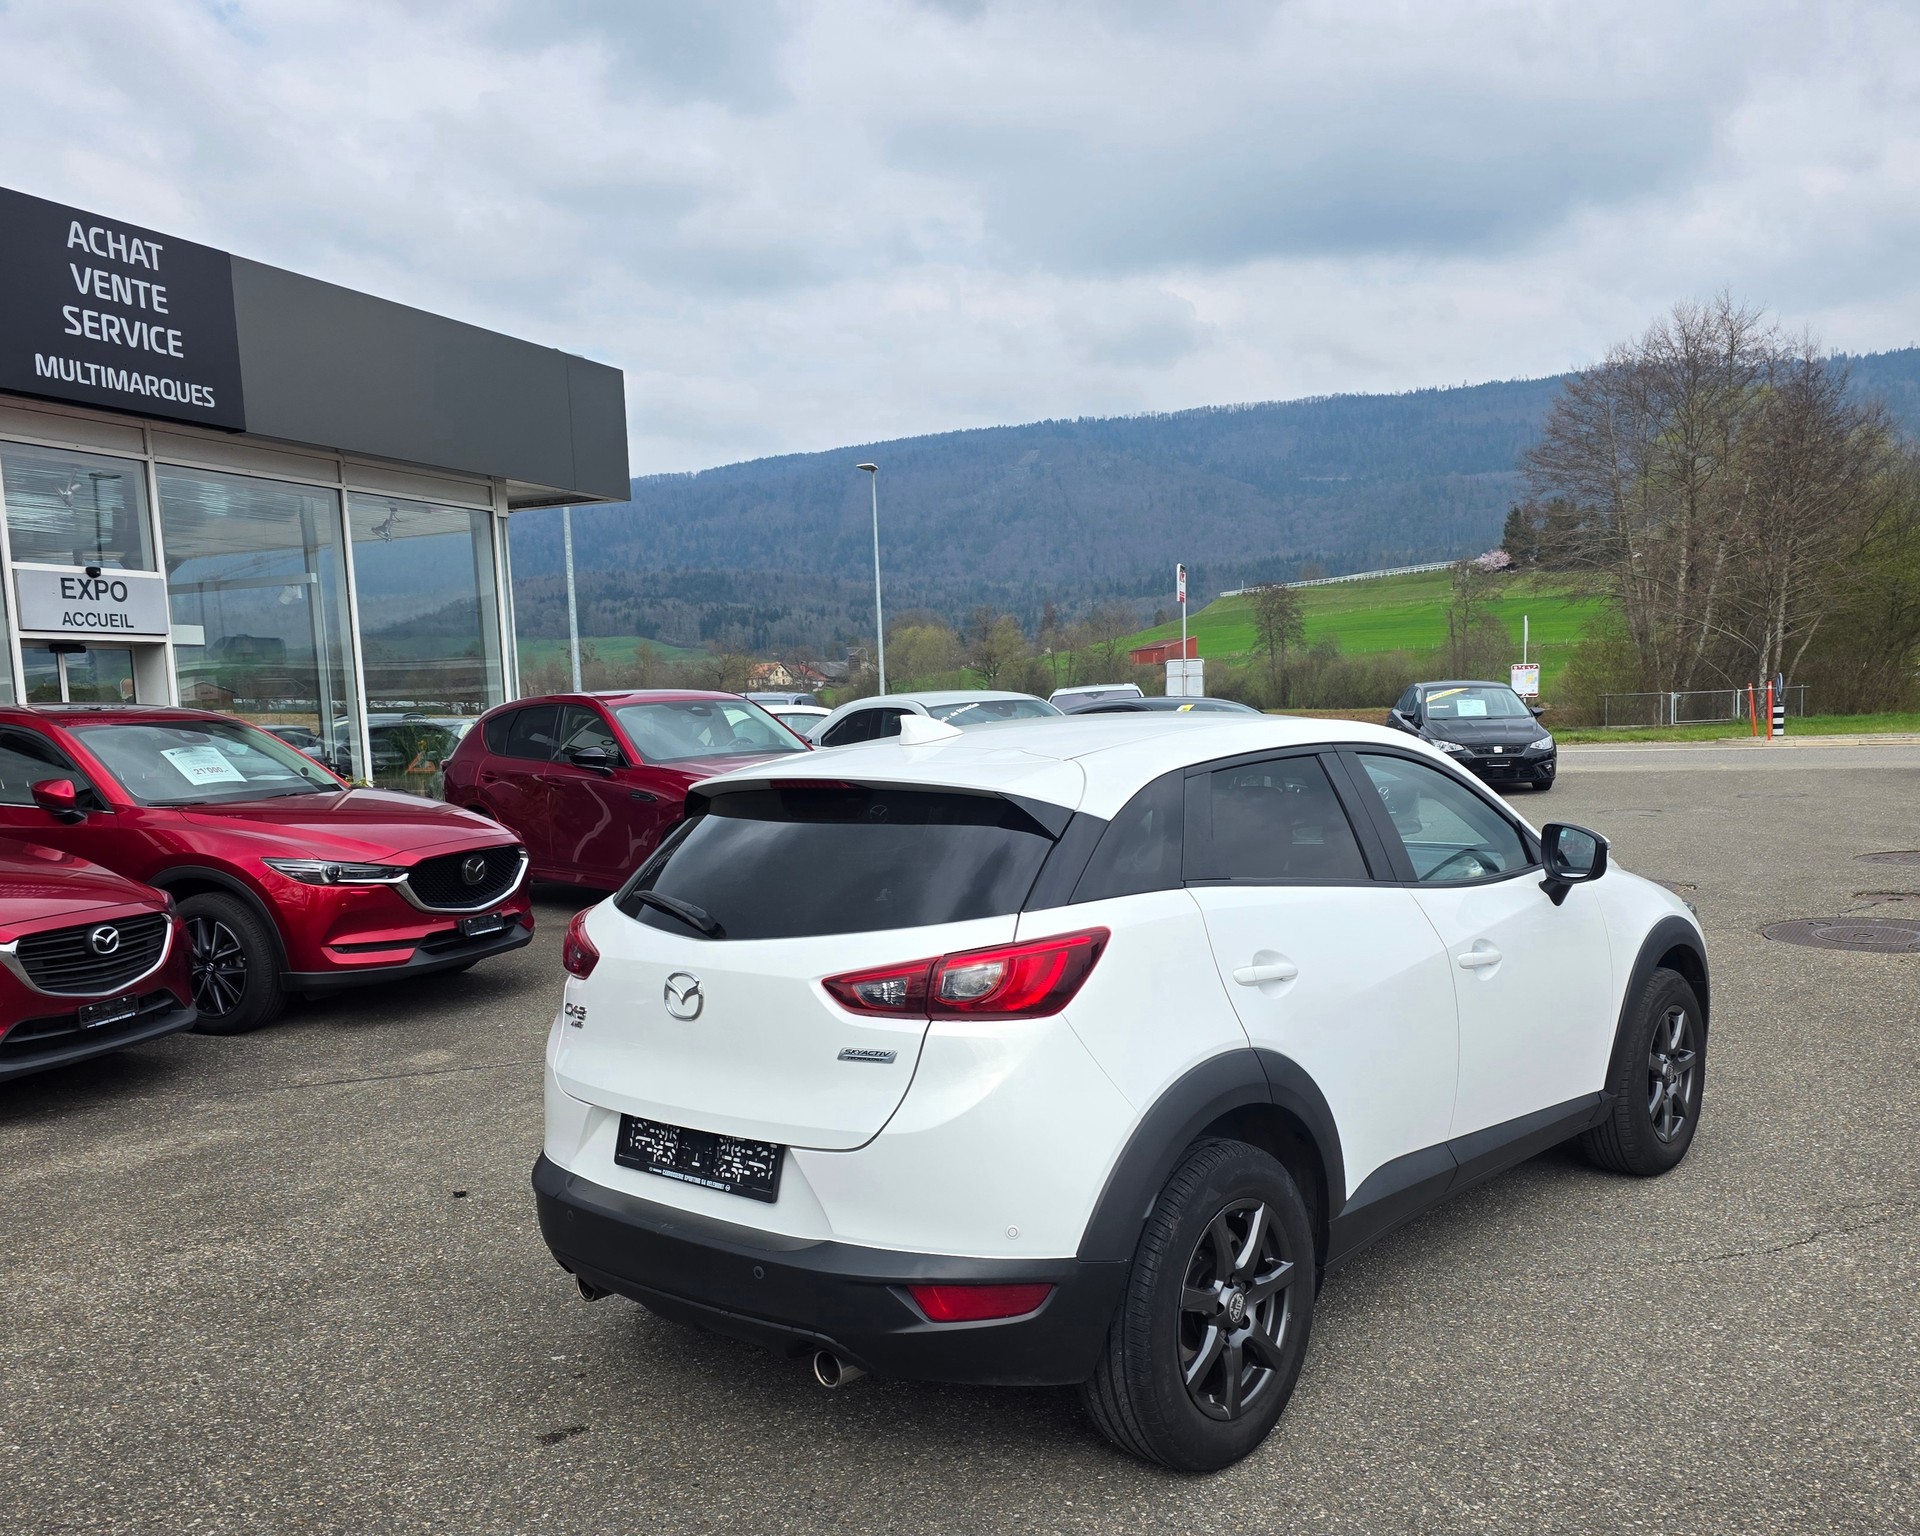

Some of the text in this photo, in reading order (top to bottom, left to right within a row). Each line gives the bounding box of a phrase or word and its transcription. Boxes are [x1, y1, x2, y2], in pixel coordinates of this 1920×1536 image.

[67, 220, 163, 271] ACHAT
[69, 262, 169, 315] VENTE
[62, 304, 184, 359] SERVICE
[34, 353, 215, 408] MULTIMARQUES
[60, 577, 128, 603] EXPO
[62, 611, 135, 629] ACCUEIL
[844, 1049, 891, 1057] SKYACTIV
